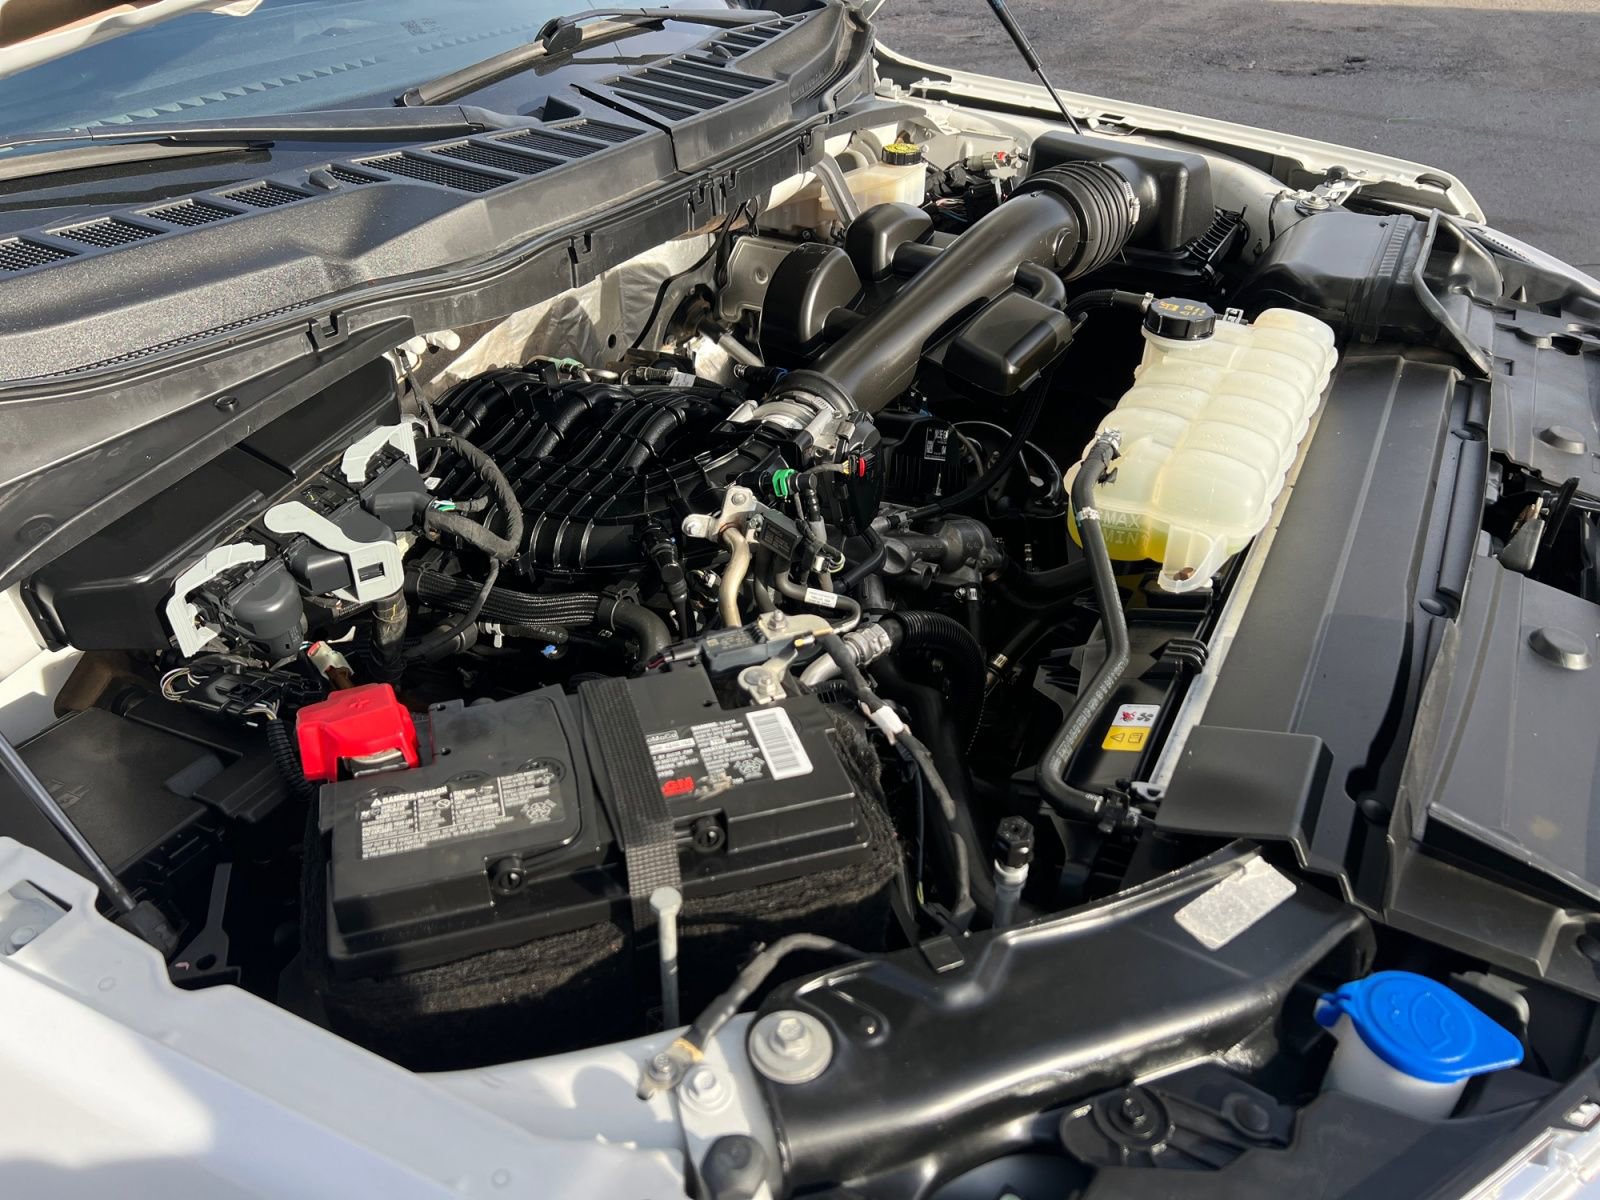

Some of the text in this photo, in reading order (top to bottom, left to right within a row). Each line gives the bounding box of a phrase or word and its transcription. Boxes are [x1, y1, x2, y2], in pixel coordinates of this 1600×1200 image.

[1102, 510, 1140, 529] MAX
[1102, 528, 1140, 545] MIN
[382, 785, 447, 804] DANGER/POISON
